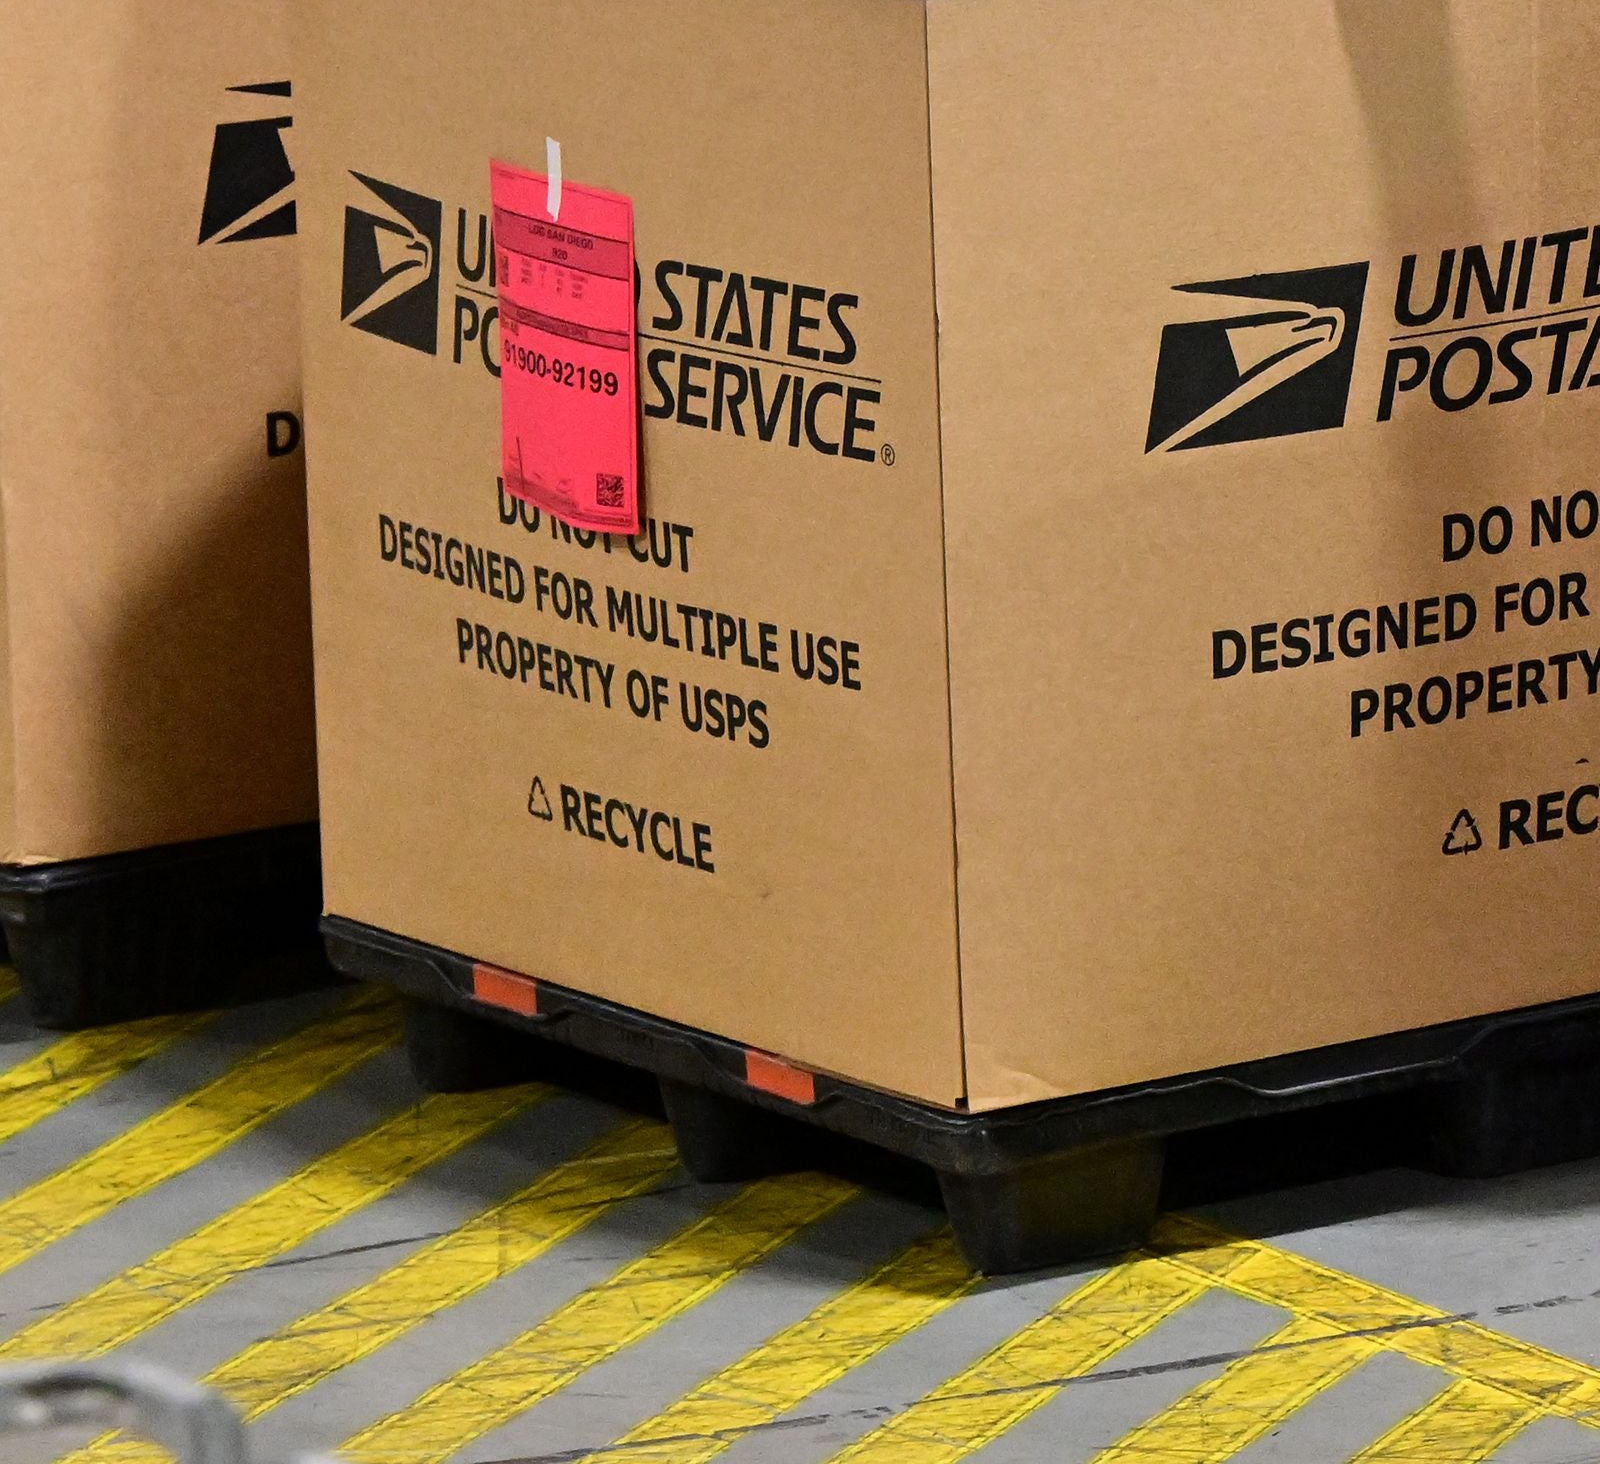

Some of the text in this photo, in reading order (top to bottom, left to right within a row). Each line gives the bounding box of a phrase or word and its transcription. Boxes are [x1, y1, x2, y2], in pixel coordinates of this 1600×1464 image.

[652, 259, 859, 365] STATES
[503, 338, 619, 397] 91900-92199
[1442, 506, 1514, 563] DO
[379, 513, 525, 604] DESIGNED
[534, 565, 598, 629] FOR
[606, 585, 780, 674] MULTIPLE
[790, 628, 862, 691] USE
[1212, 592, 1477, 680] DESIGNED
[1495, 572, 1590, 632] FOR
[456, 617, 770, 750] PROPERTY OF USPS
[560, 783, 715, 874] RECYCLE
